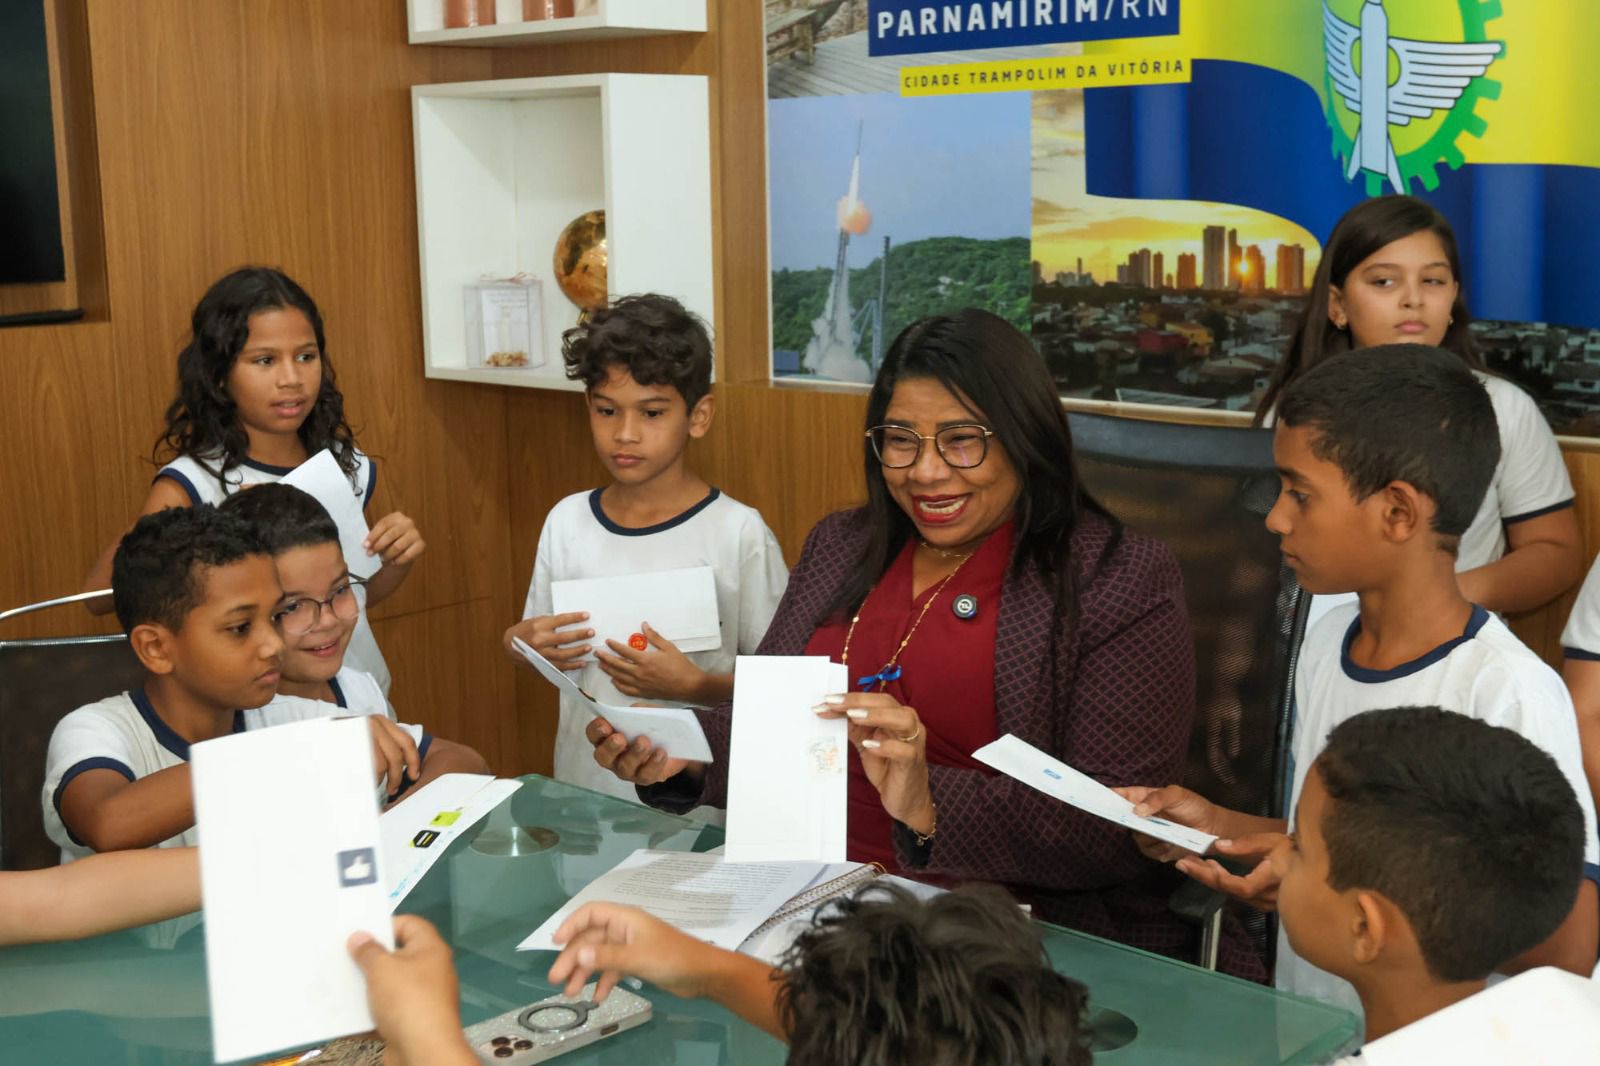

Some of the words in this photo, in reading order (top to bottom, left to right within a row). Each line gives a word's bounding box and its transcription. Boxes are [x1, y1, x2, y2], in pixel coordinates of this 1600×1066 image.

[877, 0, 1167, 38] PARNAMIRIM/RN
[904, 73, 960, 88] CIDADE
[969, 66, 1066, 84] TRAMPOLIM
[1076, 64, 1097, 78] DA
[1107, 58, 1183, 76] VITÓRIA
